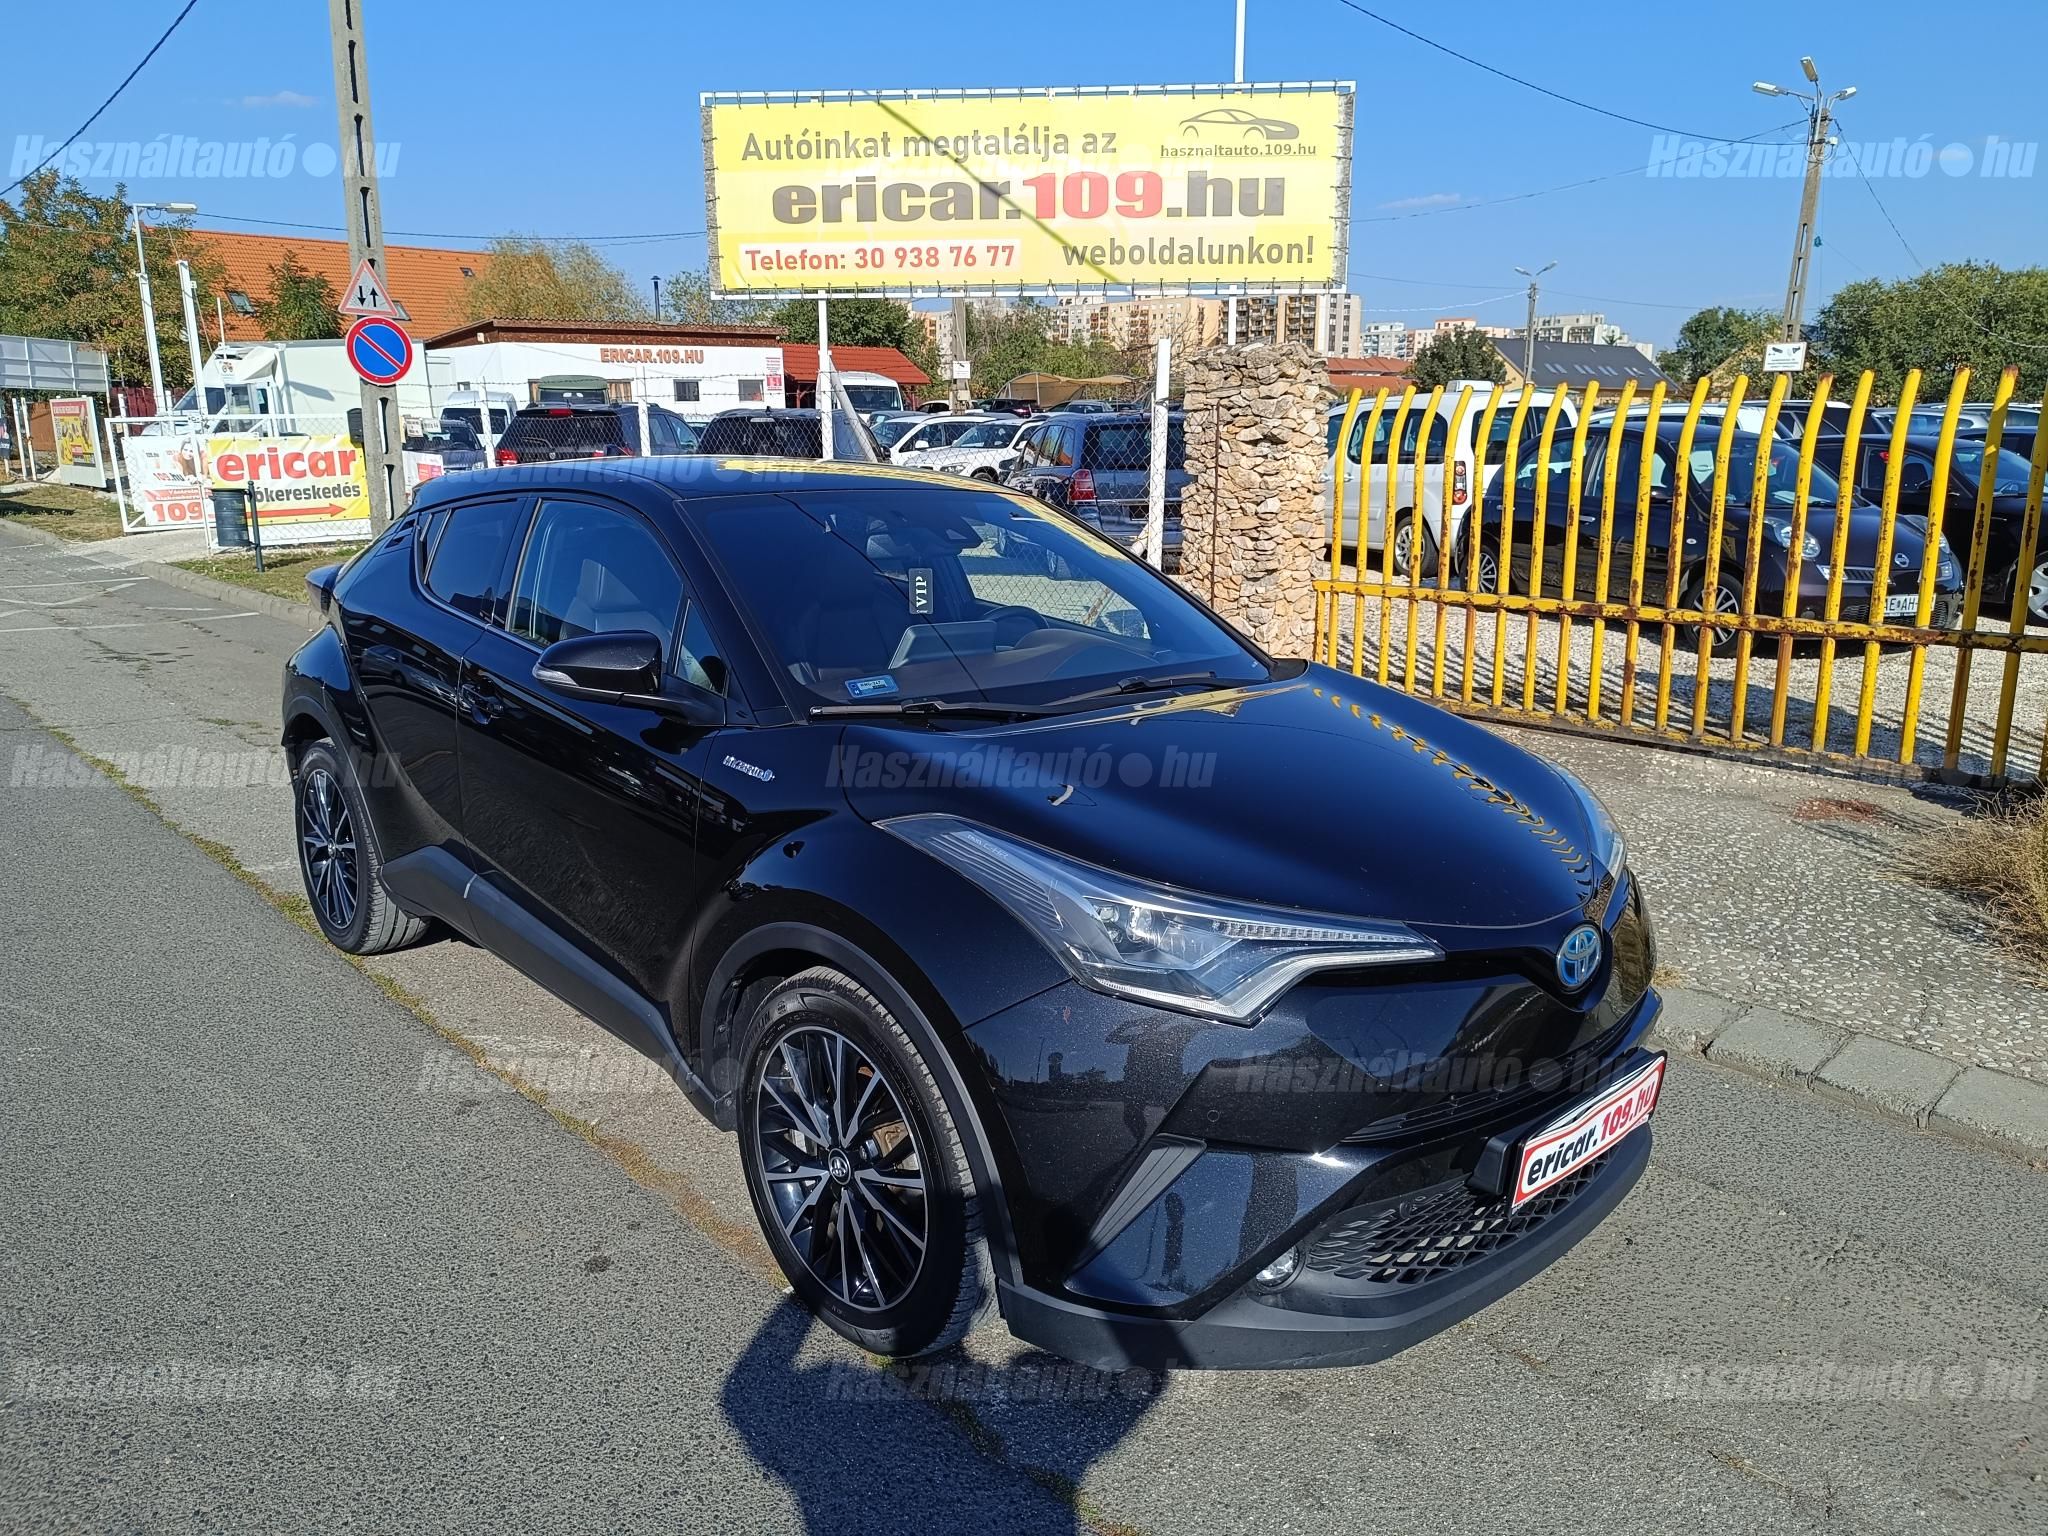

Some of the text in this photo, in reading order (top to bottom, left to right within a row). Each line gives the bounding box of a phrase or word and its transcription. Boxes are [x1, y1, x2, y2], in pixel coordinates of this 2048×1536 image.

[741, 122, 1117, 163] Autóinkat megtalálja az
[772, 170, 1285, 225] ericar.109.hu
[745, 245, 1015, 271] Telefon: 30 938 76 77
[1062, 235, 1314, 266] weboldalunkon!
[600, 348, 705, 364] ERICAR.109.HU
[216, 447, 356, 482] ericar
[255, 482, 361, 504] ókereskedés
[915, 576, 928, 608] VIP
